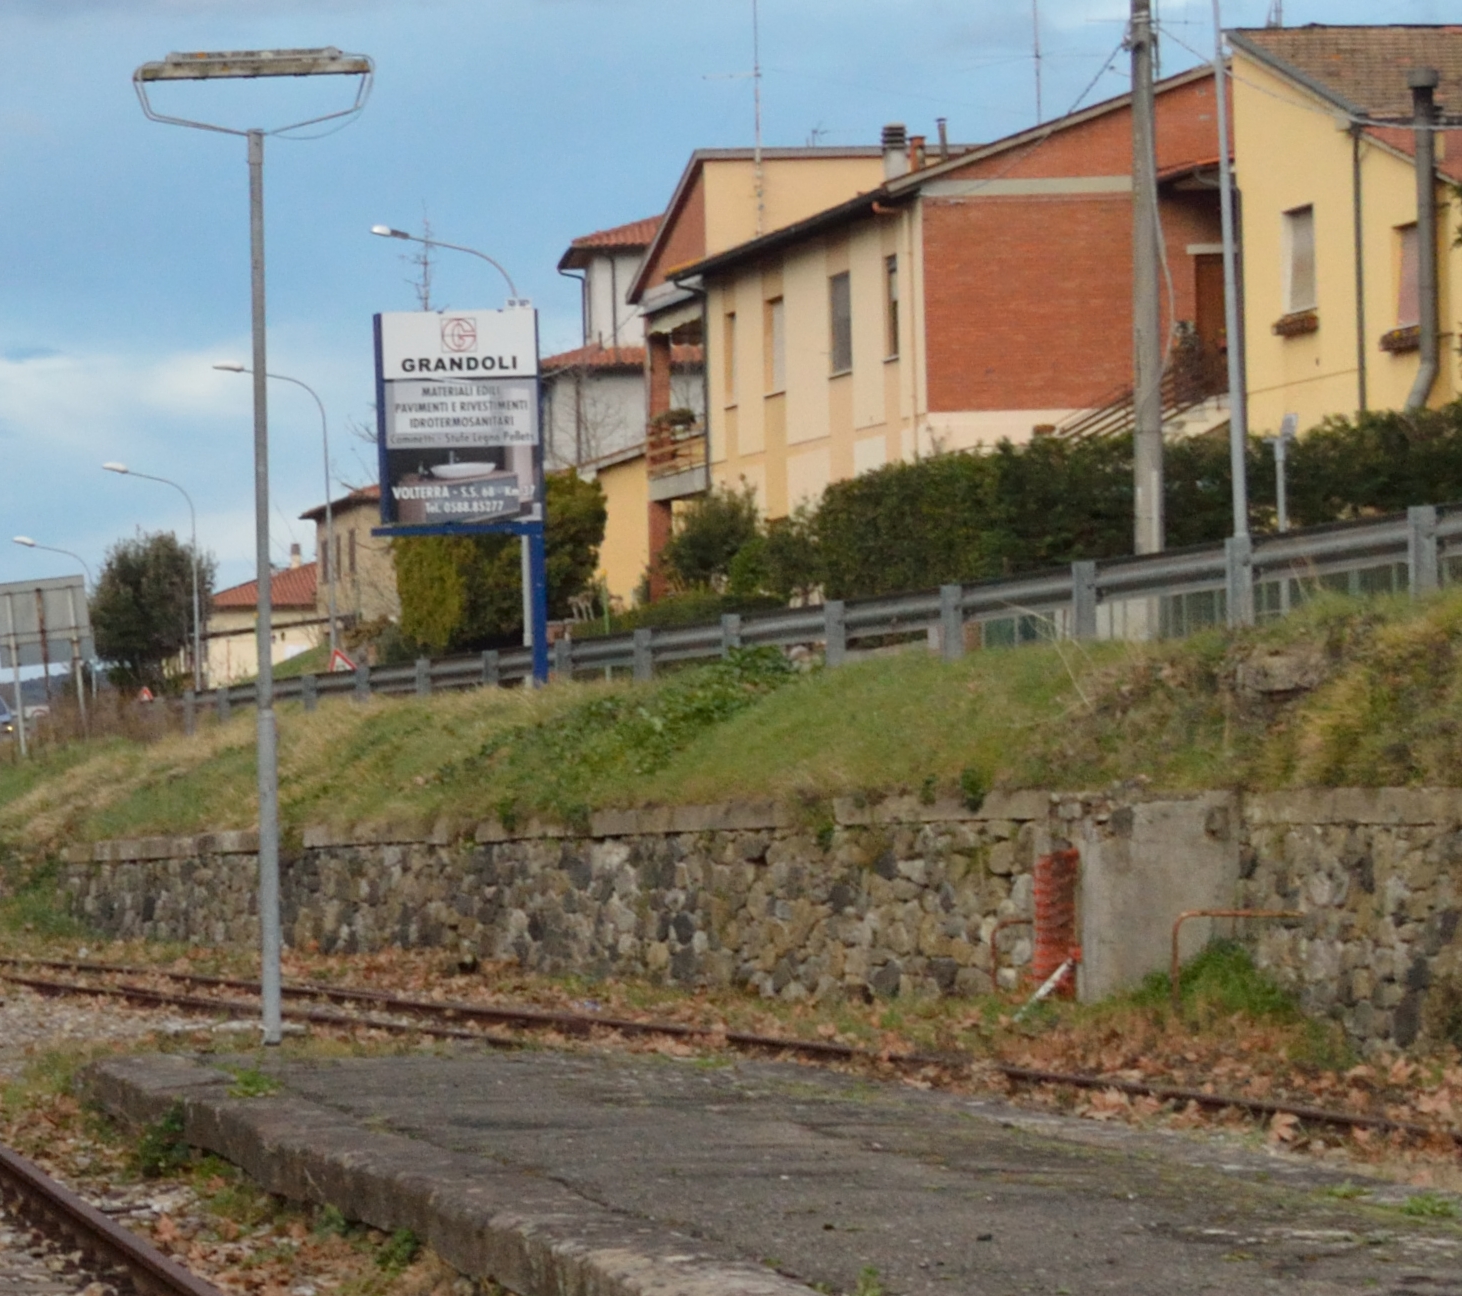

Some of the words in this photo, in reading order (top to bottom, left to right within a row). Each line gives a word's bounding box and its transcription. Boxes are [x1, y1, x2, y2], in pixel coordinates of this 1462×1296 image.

[402, 356, 517, 372] GRANDOLI
[422, 387, 473, 397] MATERIALI
[477, 386, 500, 396] EDILI
[395, 402, 448, 413] PAVIMENTI
[460, 400, 528, 412] RIVESTIMENTI
[409, 416, 514, 428] IDROTERMOSANITARI
[446, 433, 470, 443] Stufe
[473, 433, 500, 445] Legno
[391, 486, 450, 500] VOLTERRA
[461, 486, 479, 497] S.S.
[425, 501, 442, 513] Tel.
